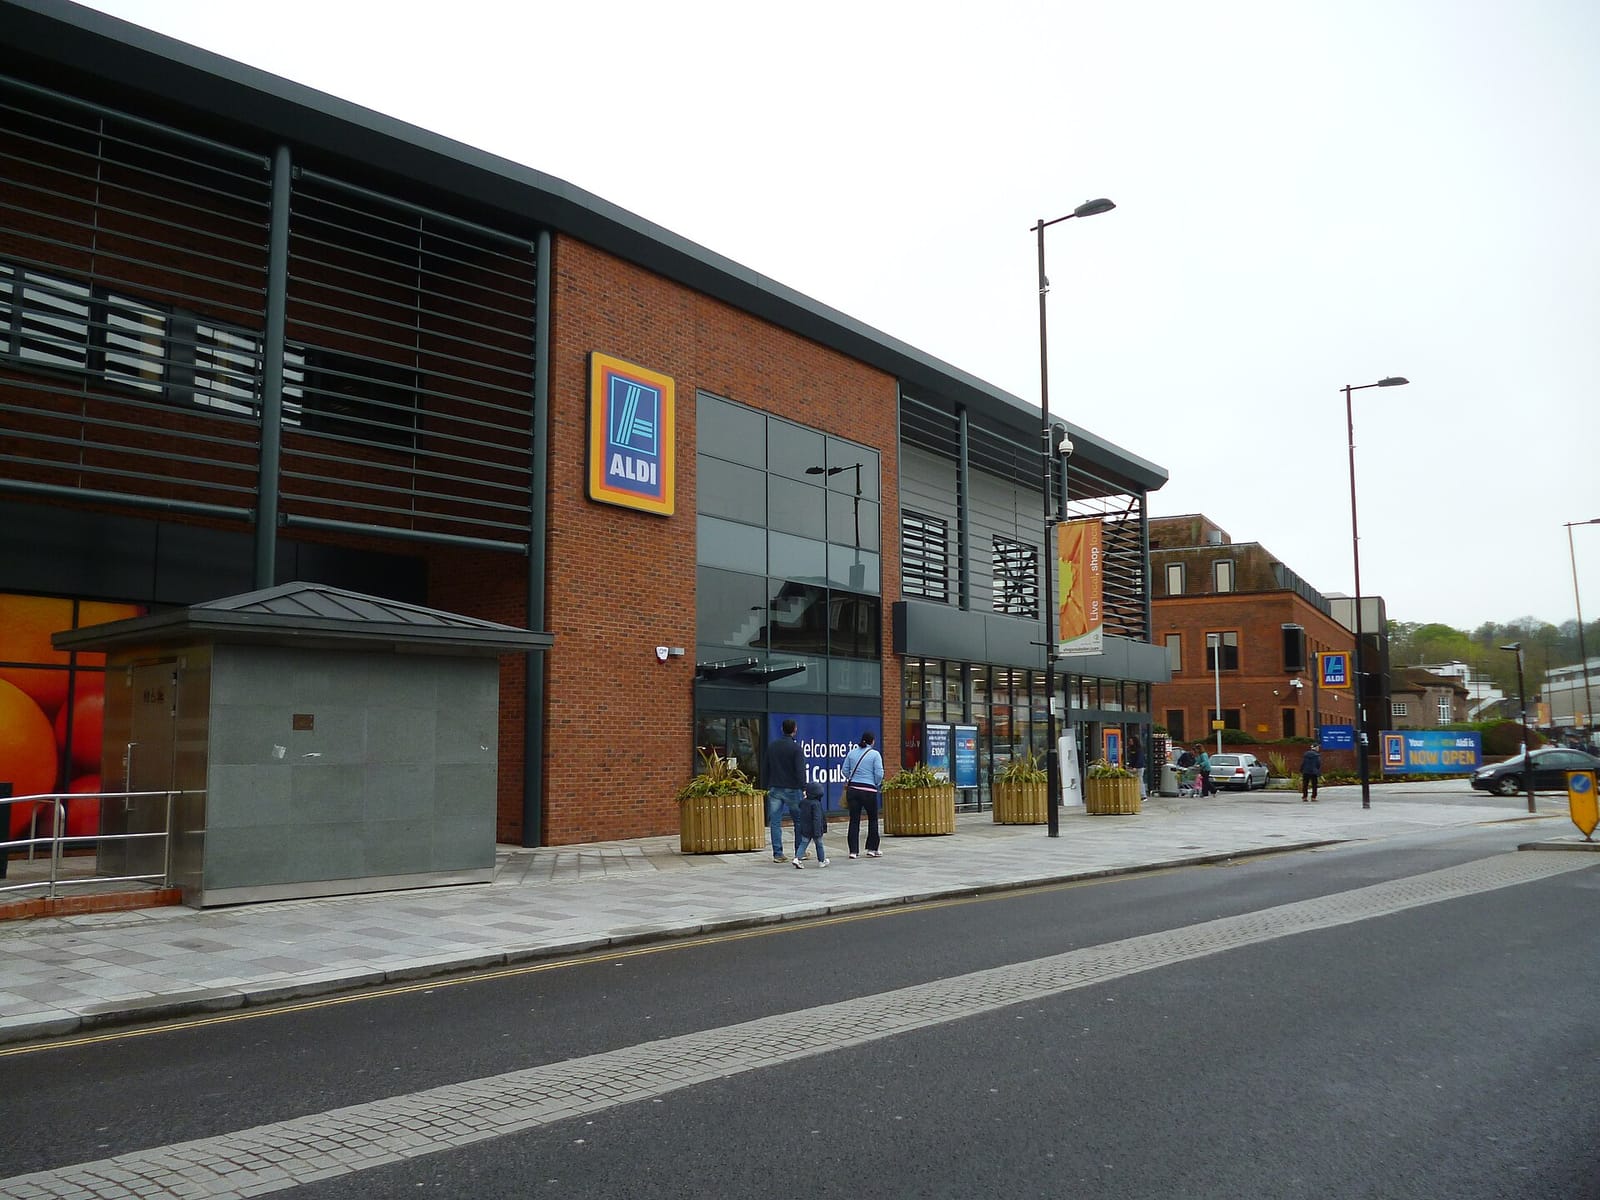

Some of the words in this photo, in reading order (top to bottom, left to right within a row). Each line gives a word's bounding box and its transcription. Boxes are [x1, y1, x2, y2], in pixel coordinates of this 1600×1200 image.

[609, 452, 657, 486] ALDI
[1090, 547, 1100, 573] shop
[1090, 600, 1099, 622] Live
[1410, 751, 1438, 765] NOW
[1442, 751, 1475, 765] OPEN
[812, 764, 849, 783] Couls
